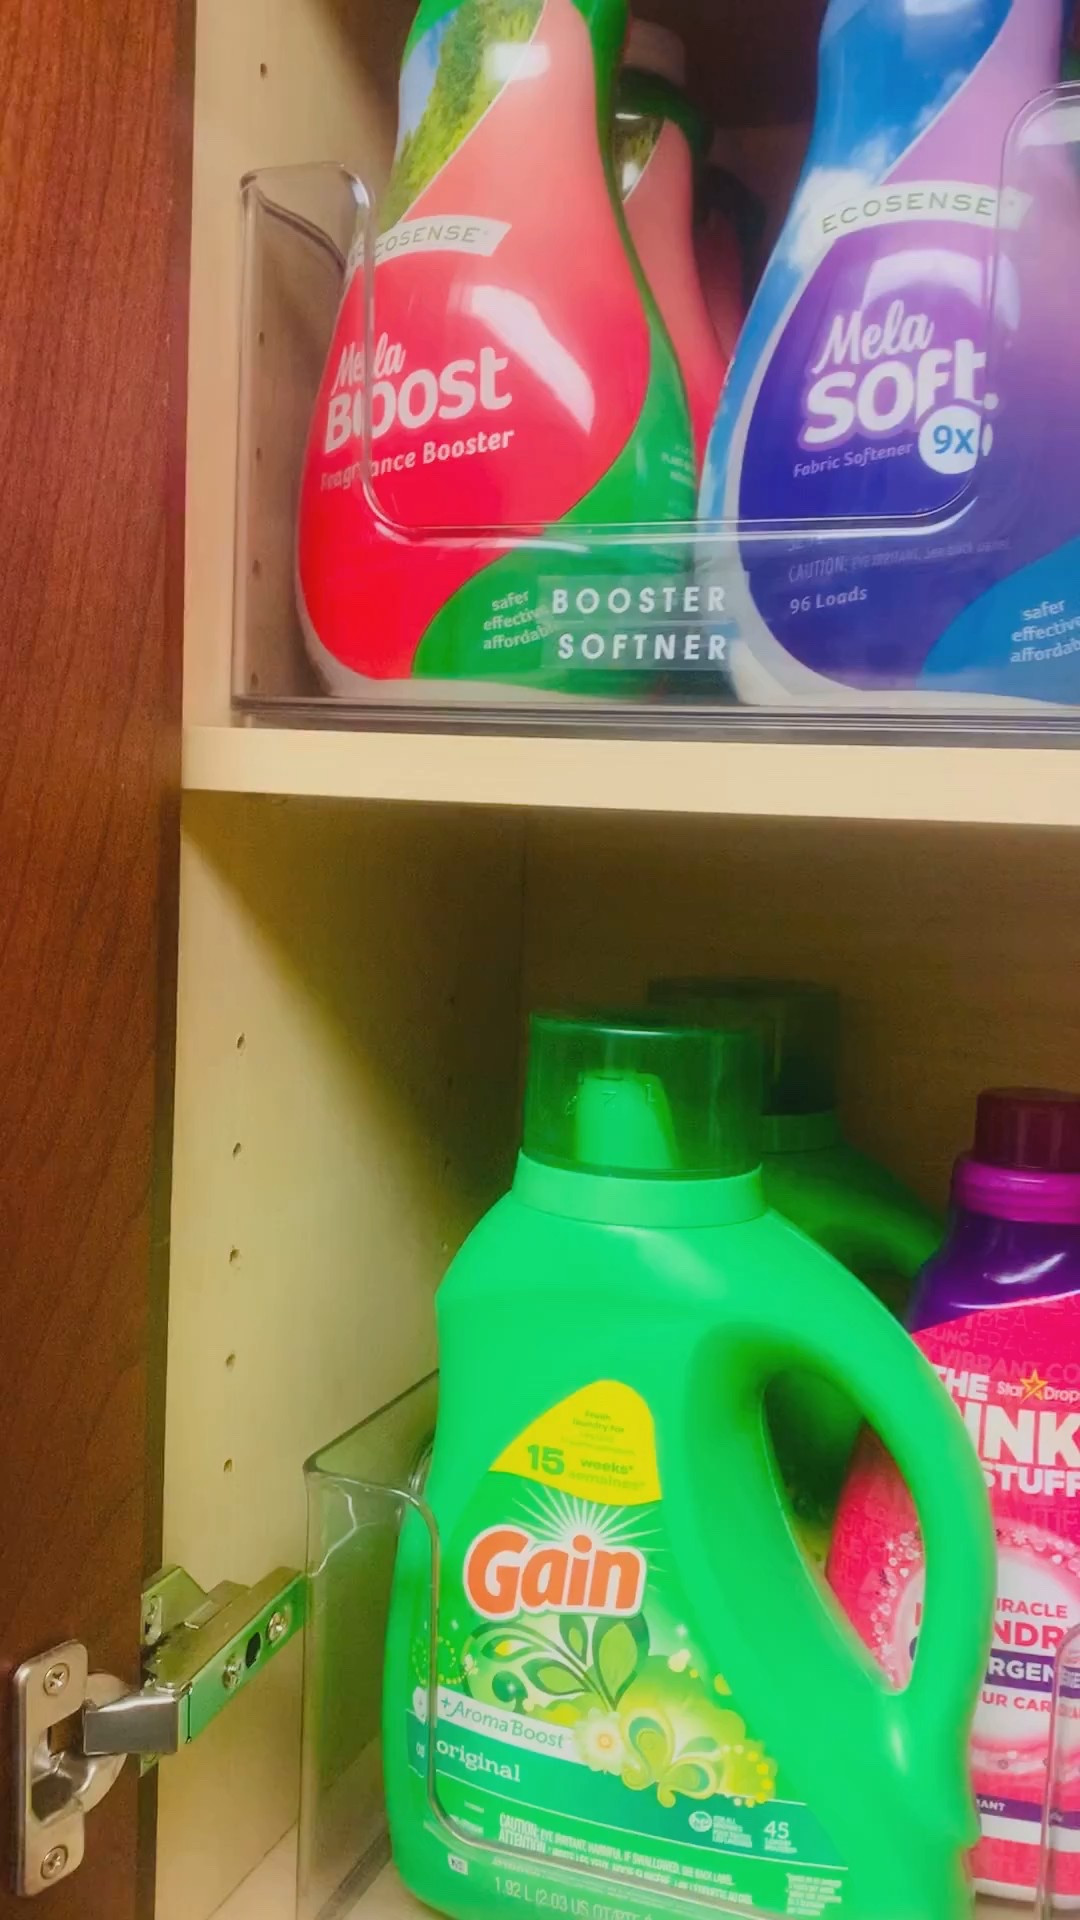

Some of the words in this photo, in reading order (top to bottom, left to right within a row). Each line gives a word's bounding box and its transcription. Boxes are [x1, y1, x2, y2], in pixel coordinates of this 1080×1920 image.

[820, 192, 996, 234] ECOSENSE
[811, 299, 935, 375] Mela
[423, 430, 515, 464] Booster
[793, 455, 840, 478] Fabric
[843, 443, 914, 467] Softener
[491, 590, 530, 612] safer
[552, 586, 727, 614] BOOSTER
[789, 597, 811, 615] 96
[815, 586, 868, 609] Loads
[1022, 600, 1065, 620] safer
[557, 633, 728, 660] SOFTNER
[1010, 637, 1080, 662] affordab
[1044, 1386, 1080, 1403] Drop
[527, 1444, 565, 1475] 15
[466, 1529, 641, 1615] Gain
[996, 1597, 1068, 1619] IRACLE
[436, 1739, 521, 1783] original
[763, 1820, 790, 1840] 45
